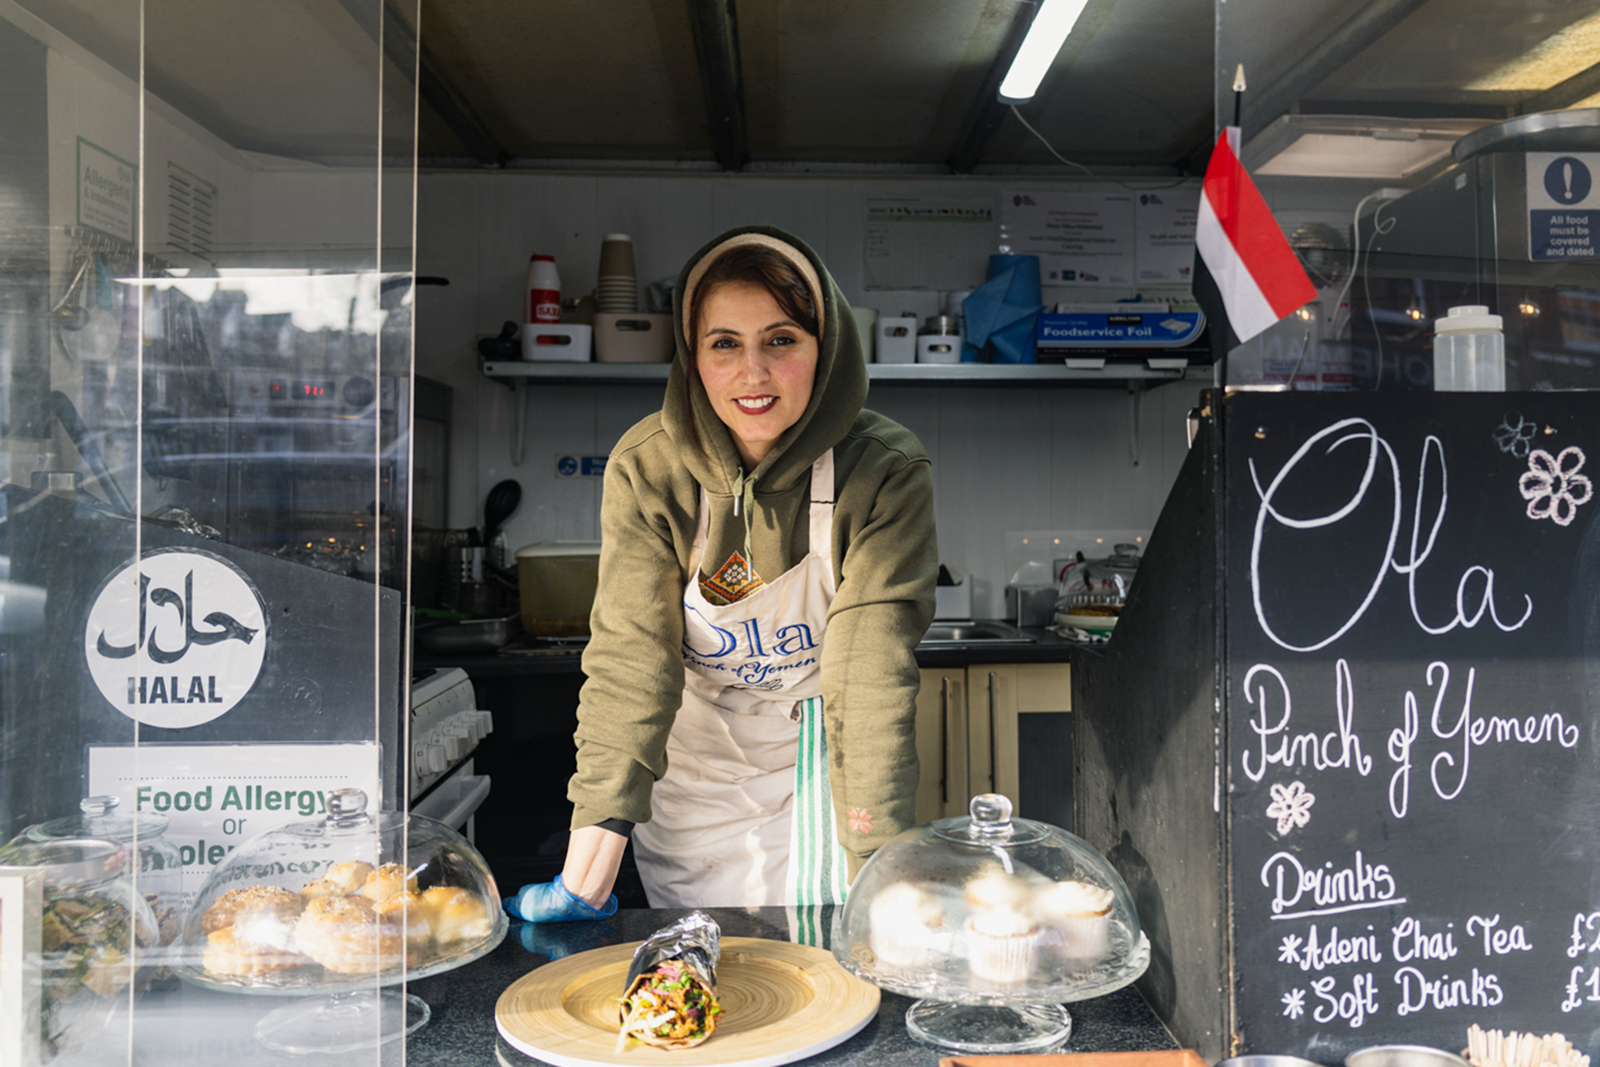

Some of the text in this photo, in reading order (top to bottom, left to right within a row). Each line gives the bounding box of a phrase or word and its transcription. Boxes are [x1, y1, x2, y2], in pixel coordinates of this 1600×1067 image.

[84, 166, 130, 201] Allergens
[1549, 226, 1590, 235] must be
[1550, 215, 1589, 225] All food
[1546, 247, 1595, 256] and dated
[1550, 237, 1590, 246] covered
[1043, 326, 1153, 337] Foodservice Foil
[1249, 416, 1533, 652] Ola
[97, 568, 260, 665] حلال
[731, 666, 746, 678] of
[744, 656, 818, 685] Yemen
[127, 675, 224, 704] HALAL
[1242, 657, 1580, 819] Pinch of Yemen
[137, 785, 333, 817] Food Allergy
[222, 818, 247, 835] or
[1260, 850, 1396, 914] Drinks
[1300, 925, 1382, 970] Adeni
[1392, 917, 1458, 962] Chai
[1466, 914, 1533, 956] Tea
[1311, 971, 1379, 1028] Soft
[1394, 967, 1504, 1016] Drinks
